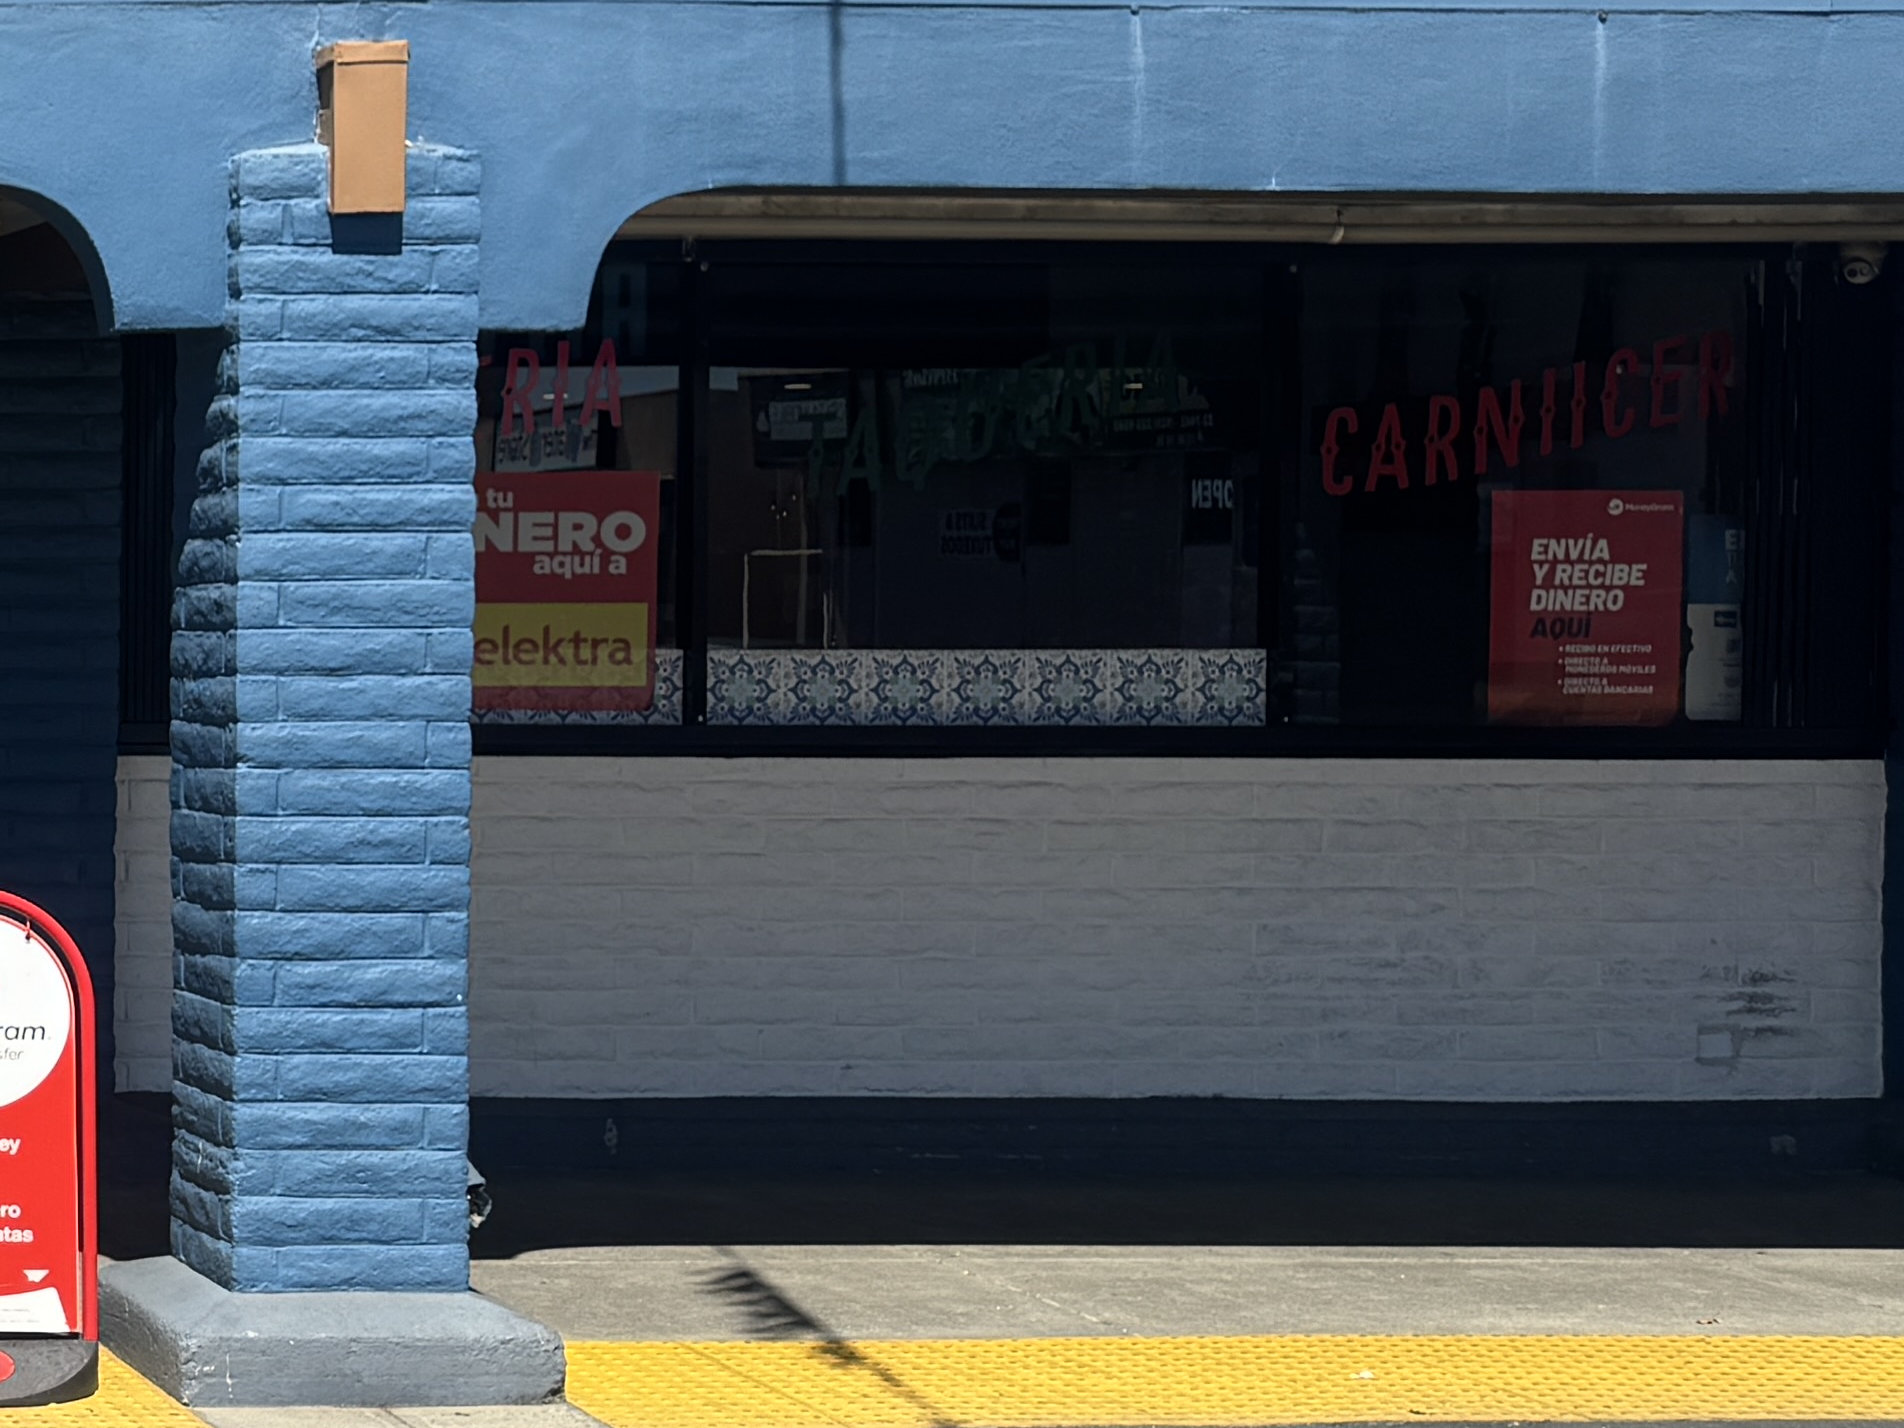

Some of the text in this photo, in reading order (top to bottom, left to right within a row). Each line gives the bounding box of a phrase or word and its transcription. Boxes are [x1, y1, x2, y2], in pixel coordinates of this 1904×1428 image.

[486, 488, 514, 509] tu
[1530, 533, 1611, 561] ENVÍA
[533, 548, 628, 580] aquí a
[1533, 563, 1648, 586] Y RECIBE
[1529, 588, 1625, 612] DINERO
[1530, 612, 1592, 641] AQUÍ
[474, 624, 634, 666] elektra
